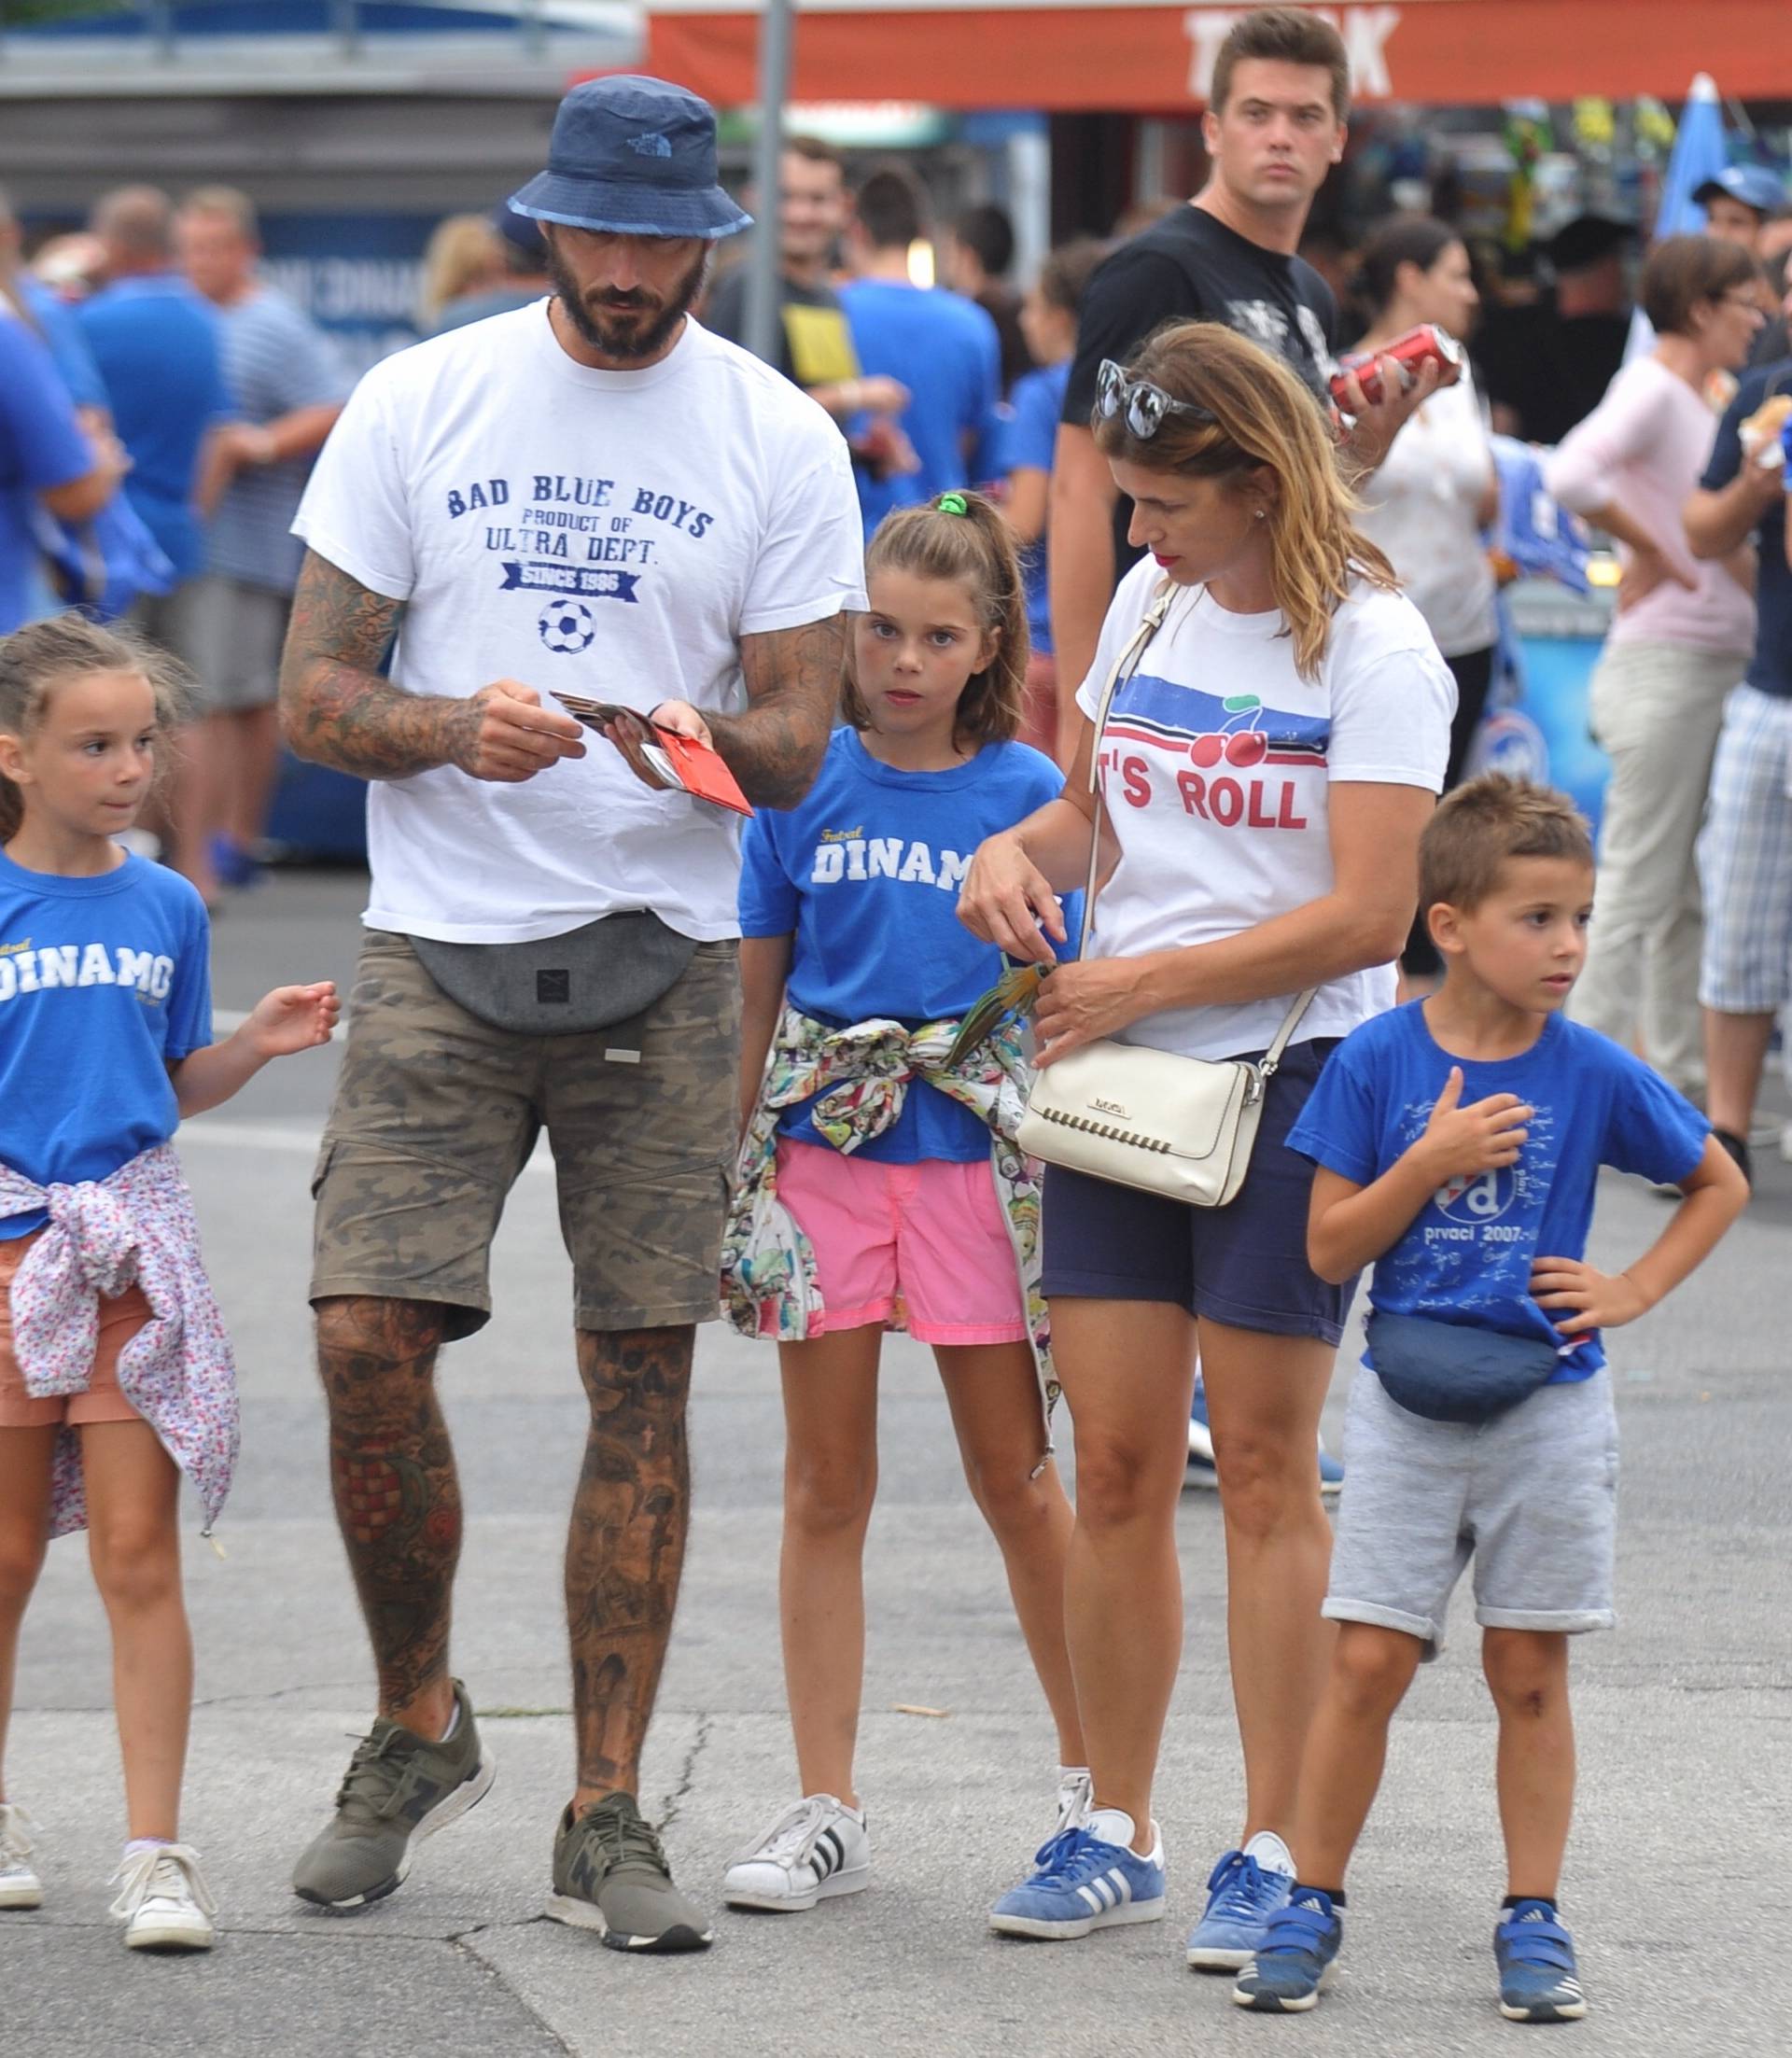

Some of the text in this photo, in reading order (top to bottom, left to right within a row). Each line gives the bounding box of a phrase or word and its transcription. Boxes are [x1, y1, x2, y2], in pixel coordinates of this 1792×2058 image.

[447, 475, 715, 539] BAD BLUE BOYS
[522, 509, 633, 534] PRODUCT OF
[485, 527, 567, 557] ULTRA
[519, 566, 620, 592] SINCE 1986
[1177, 770, 1307, 830] ROLL
[810, 837, 974, 893] DINAM
[1423, 1225, 1475, 1245] prvaci
